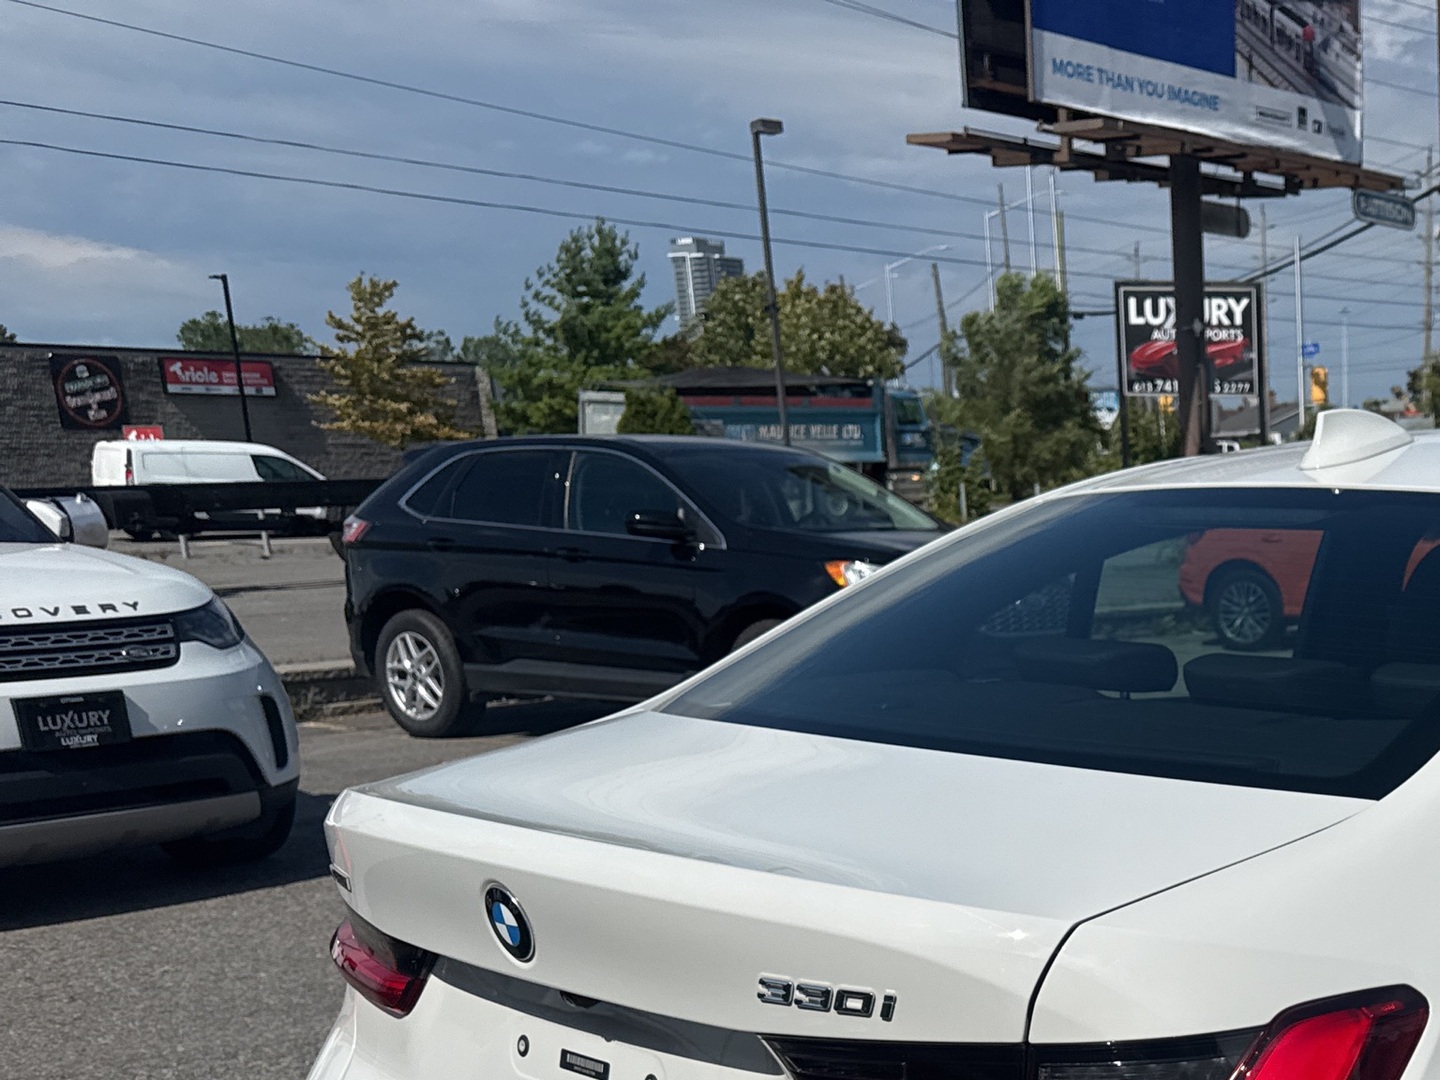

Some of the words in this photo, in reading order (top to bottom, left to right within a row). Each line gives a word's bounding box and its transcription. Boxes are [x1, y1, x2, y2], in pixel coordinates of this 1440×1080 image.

[1052, 58, 1094, 83] MORE
[1097, 68, 1135, 92] THAN
[1137, 77, 1165, 98] YOU
[1167, 84, 1220, 111] IMAGINE
[0, 601, 139, 619] OVERY
[37, 709, 110, 732] LUXURY
[61, 734, 98, 746] LUXURY
[757, 977, 897, 1022] 330i
